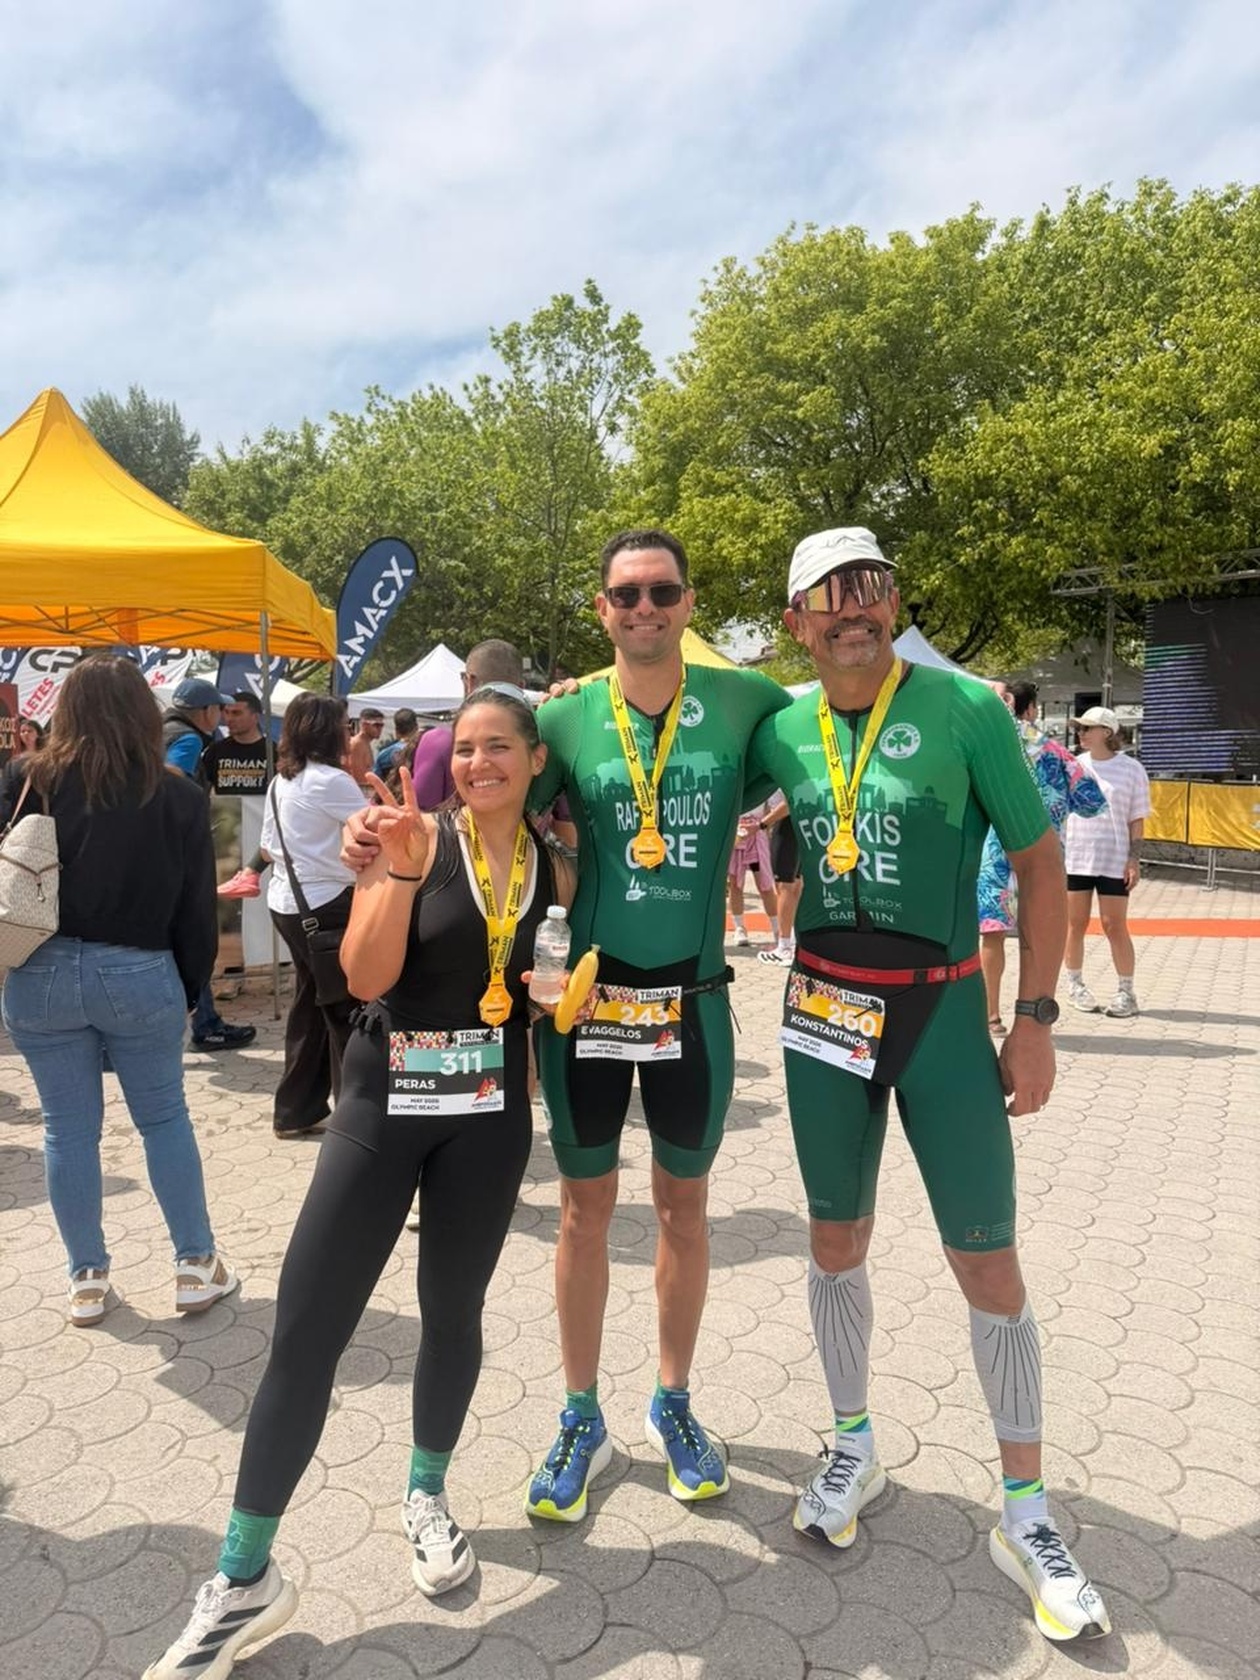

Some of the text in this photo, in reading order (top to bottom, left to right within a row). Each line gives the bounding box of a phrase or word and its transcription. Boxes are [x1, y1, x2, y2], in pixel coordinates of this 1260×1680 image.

[336, 555, 414, 678] AMACX
[218, 758, 267, 769] TRIMAN
[615, 791, 711, 831] RAFOULOS
[649, 885, 692, 898] TOOLBOX
[640, 988, 679, 1000] TRIMAN
[844, 992, 882, 1008] TRIM
[620, 1006, 669, 1027] 243
[827, 1004, 876, 1037] 260
[581, 1025, 642, 1039] EVAGGELOS
[790, 1014, 868, 1048] KONSTANTINOS
[440, 1050, 482, 1076] 311
[395, 1079, 436, 1090] PERAS
